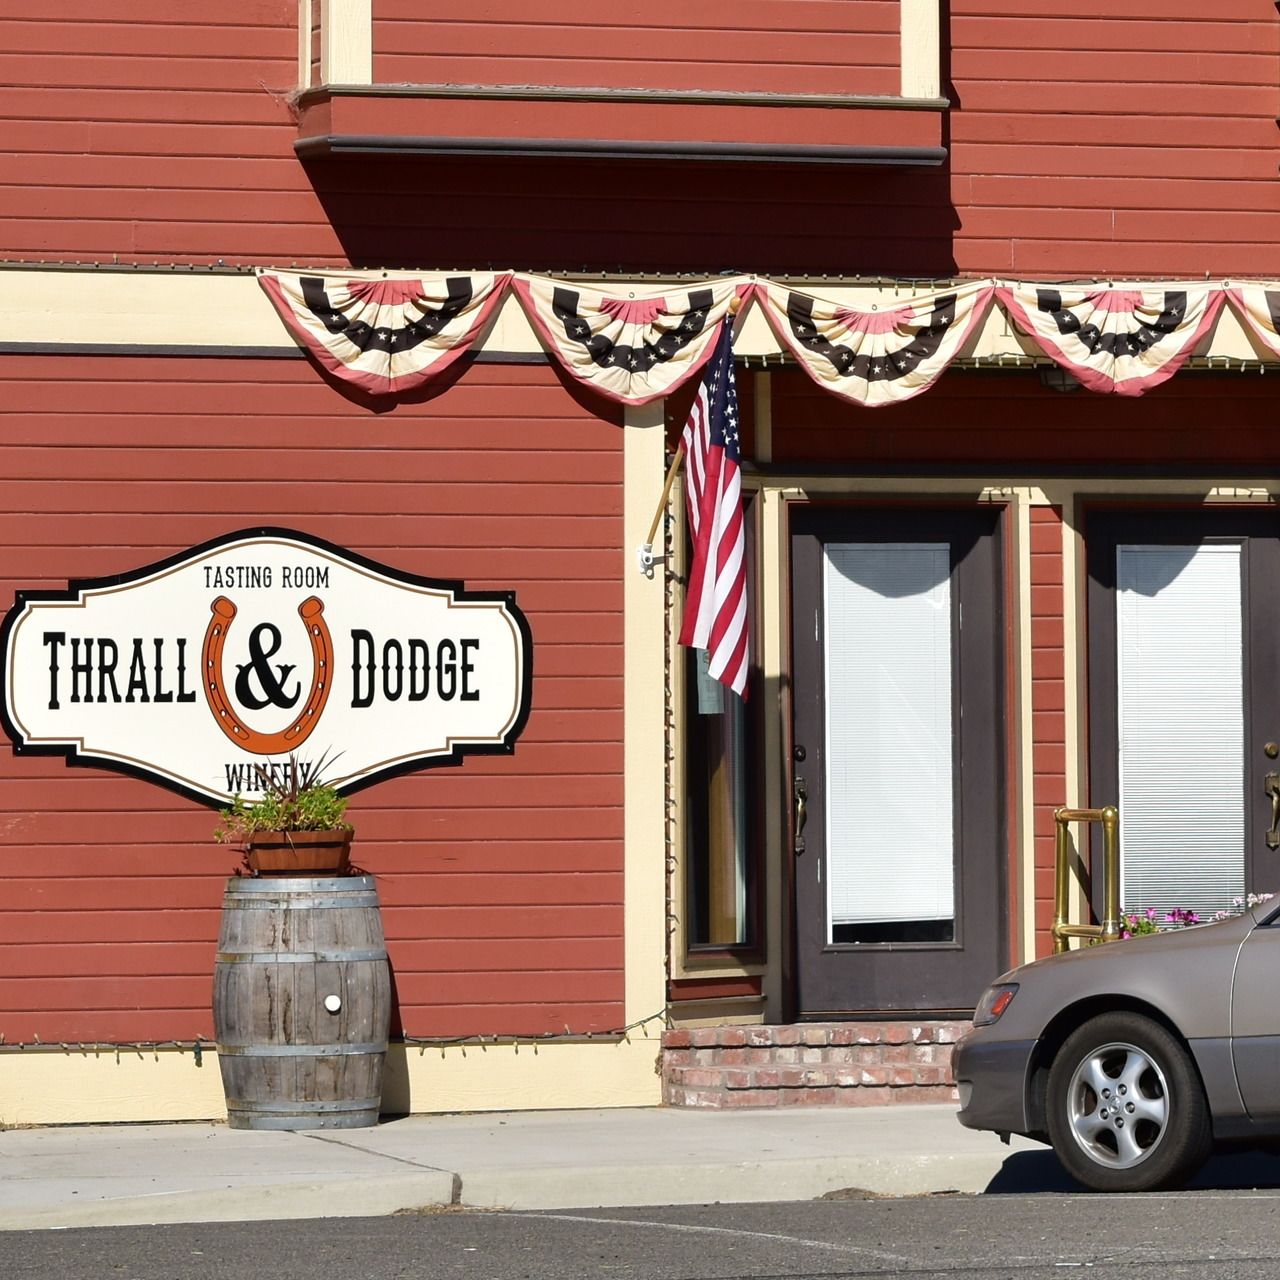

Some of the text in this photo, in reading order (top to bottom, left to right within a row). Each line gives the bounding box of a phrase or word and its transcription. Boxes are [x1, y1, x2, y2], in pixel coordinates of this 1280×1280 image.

[204, 566, 330, 589] TASTING ROOM
[43, 622, 480, 710] THRALL & DODGE
